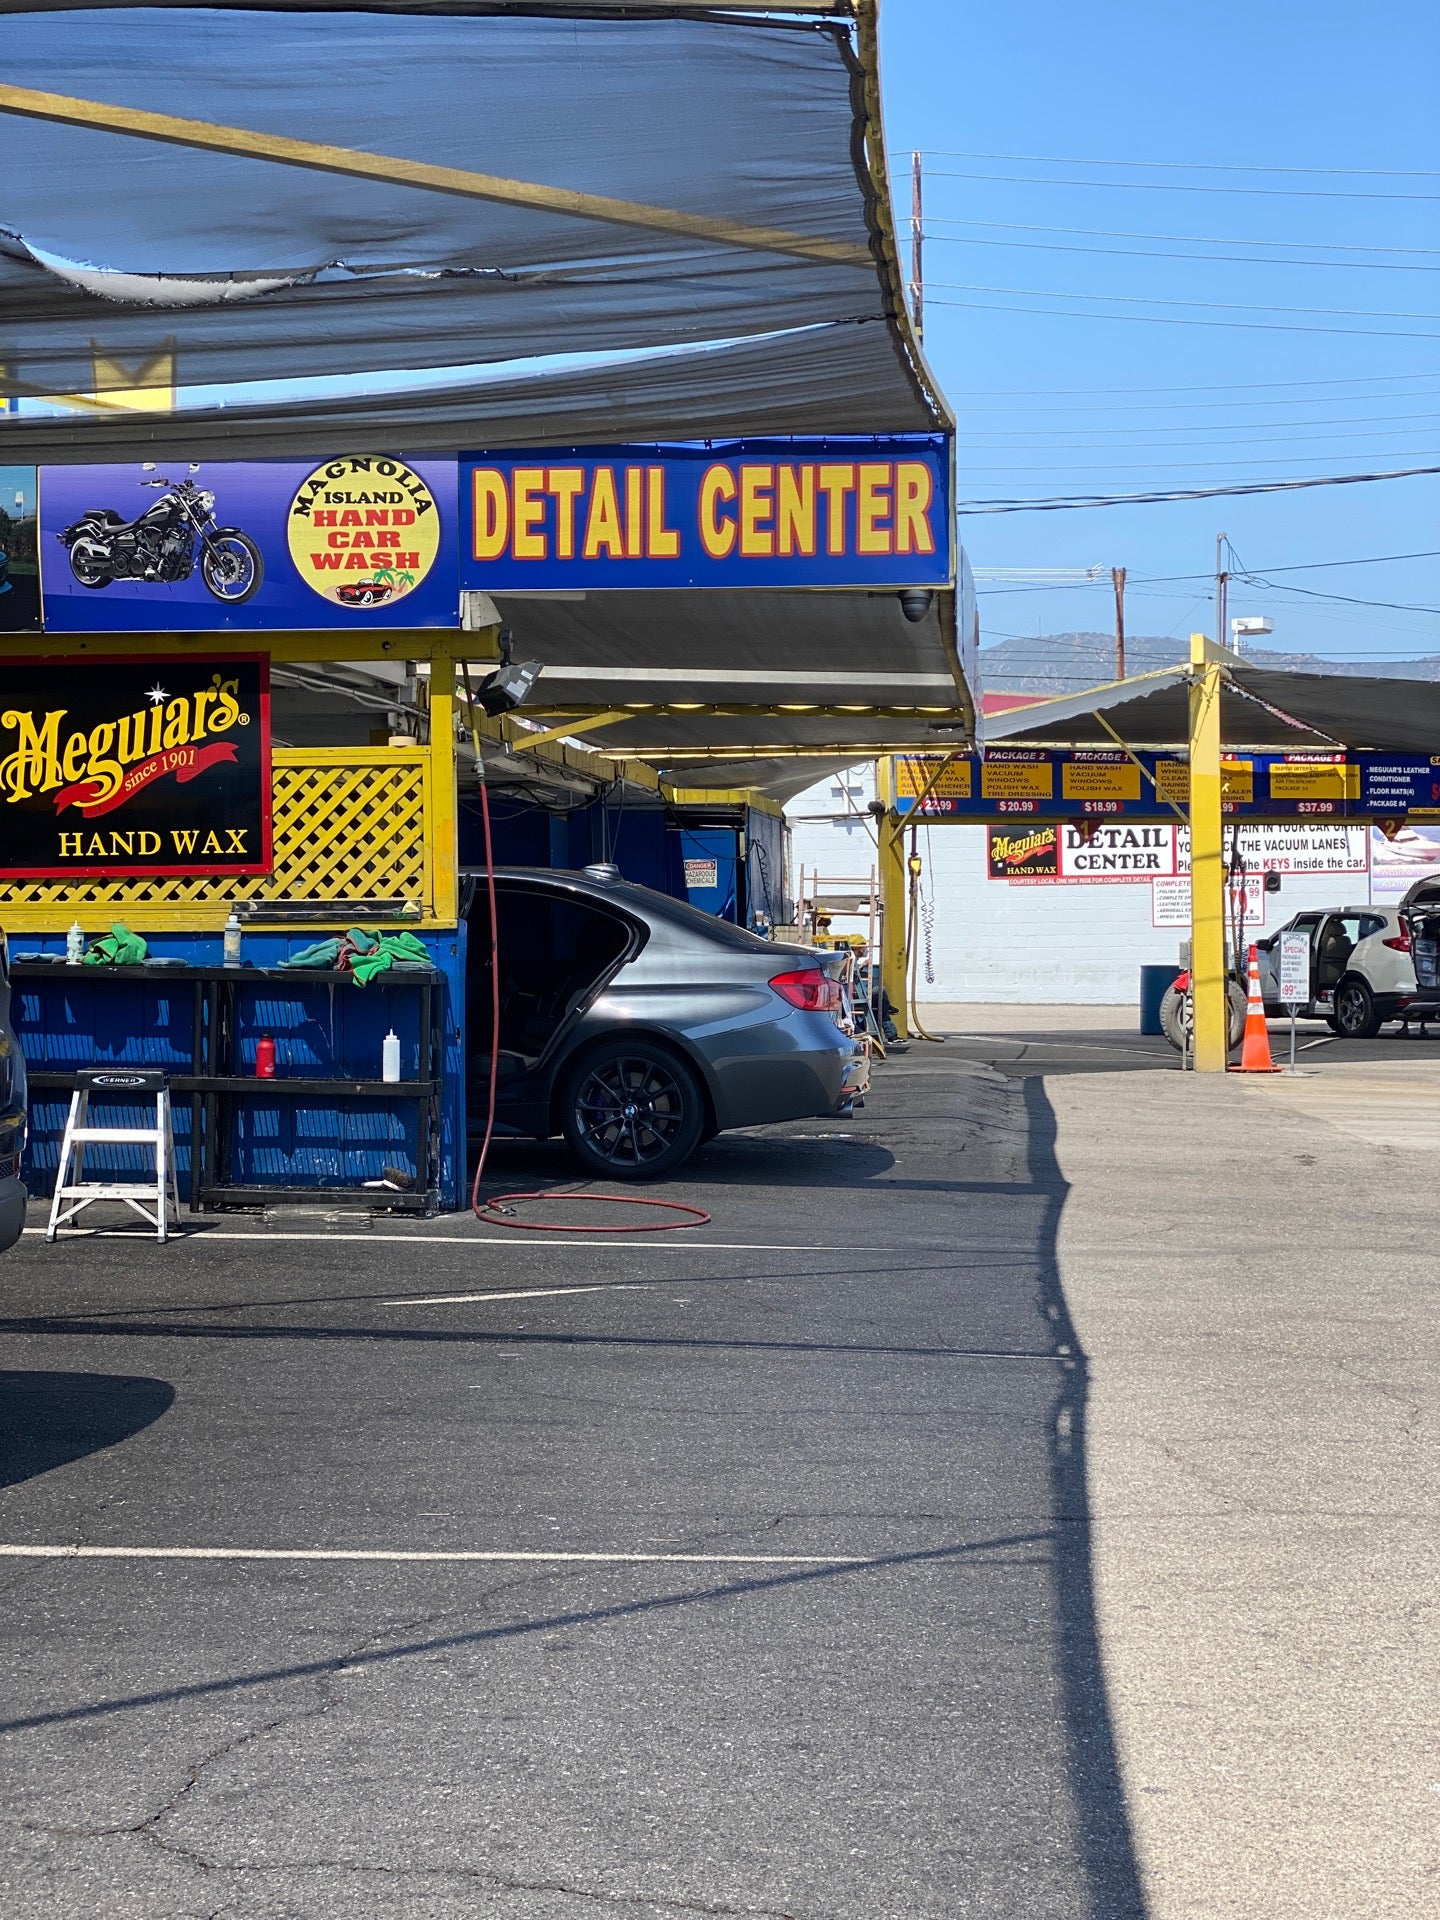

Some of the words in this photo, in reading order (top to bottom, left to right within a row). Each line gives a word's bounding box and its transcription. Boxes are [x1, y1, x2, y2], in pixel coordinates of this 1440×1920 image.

[293, 457, 433, 517] MAGNOLIA
[324, 490, 403, 505] ISLAND
[313, 509, 415, 527] HAND
[472, 465, 681, 561] DETAIL
[699, 461, 937, 559] CENTER
[327, 531, 401, 548] CAR
[310, 551, 420, 570] WASH
[989, 752, 1036, 760] PACKAGE
[1039, 752, 1046, 760] 2
[1074, 753, 1120, 761] PACKAGE
[1123, 753, 1129, 762] 1
[1288, 754, 1332, 762] PACKAGE
[1334, 754, 1341, 762] 5
[124, 760, 158, 791] since
[161, 750, 196, 772] 1901
[999, 801, 1034, 811] $20.99
[1084, 801, 1117, 812] $18.99
[1298, 802, 1333, 812] $37.99
[1080, 820, 1089, 839] 1
[1279, 824, 1304, 833] YOUR
[1309, 824, 1329, 832] CAR
[1385, 819, 1396, 837] 2
[58, 831, 161, 857] HAND
[170, 829, 248, 854] WAX
[1067, 828, 1168, 849] DETAIL
[1240, 841, 1261, 851] THE
[1265, 839, 1308, 850] VACUUM
[1074, 854, 1160, 869] CENTER
[1263, 858, 1290, 869] KEYS
[1294, 857, 1324, 868] inside
[1327, 857, 1343, 868] the
[1346, 858, 1366, 868] car.
[1007, 867, 1034, 875] HAND
[1036, 866, 1057, 874] WAX
